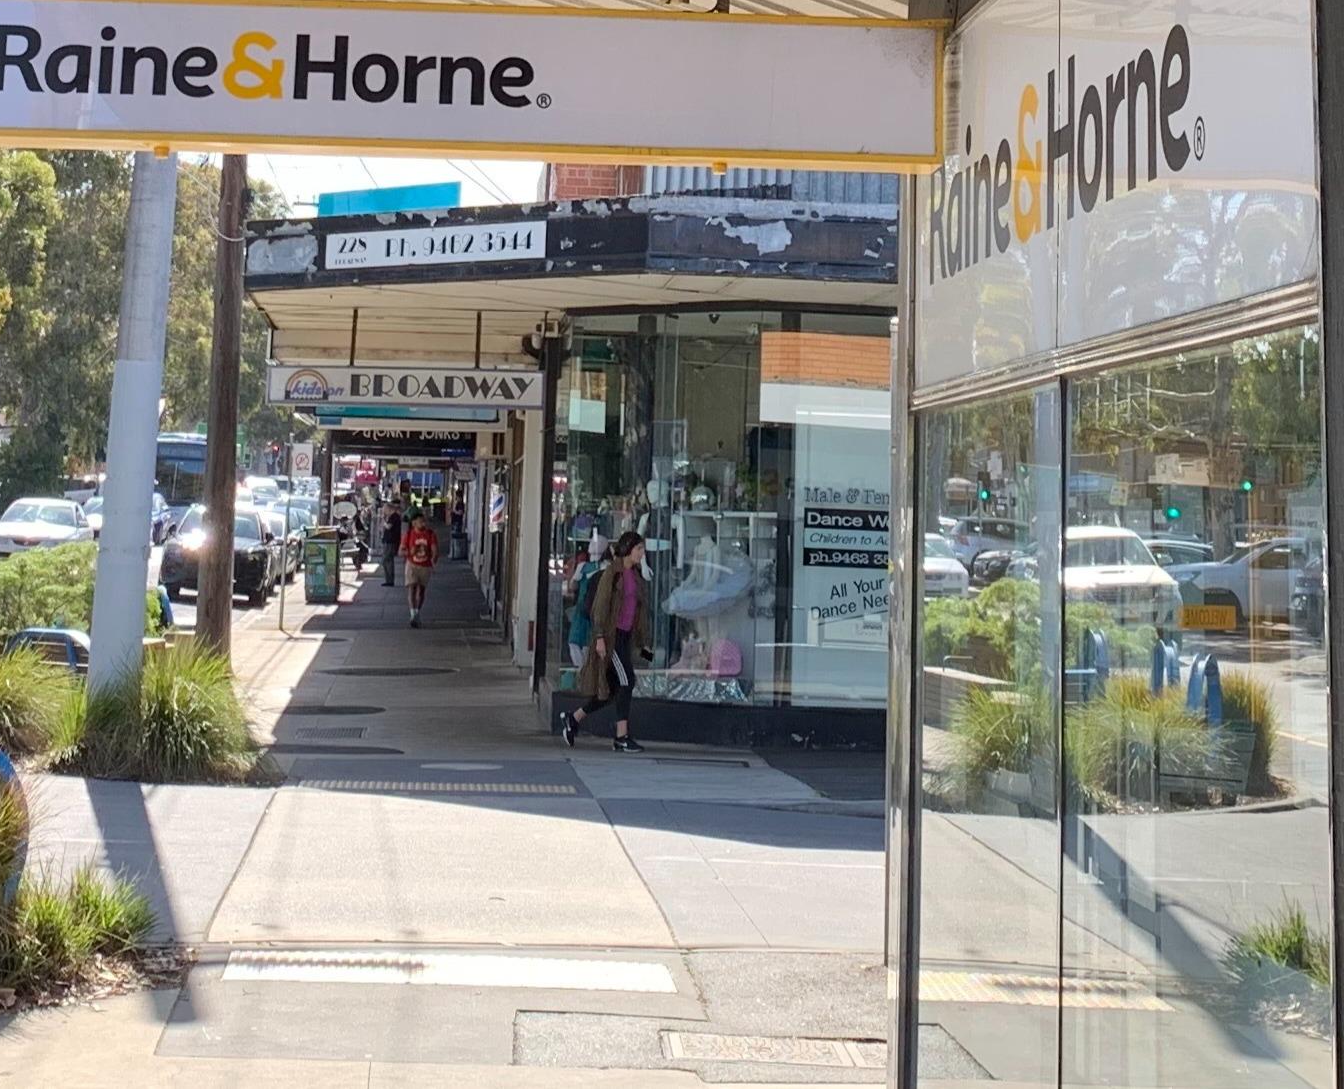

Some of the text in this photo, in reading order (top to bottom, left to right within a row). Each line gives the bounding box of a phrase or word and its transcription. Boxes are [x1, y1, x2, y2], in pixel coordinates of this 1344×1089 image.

[338, 228, 534, 258] 228 Ph. 9462 3544
[293, 373, 535, 400] kids on BROADWAY
[805, 486, 842, 504] Male
[846, 488, 860, 504] &
[807, 512, 864, 527] Dance
[809, 532, 857, 546] Children
[860, 535, 872, 546] to
[809, 551, 870, 566] ph.9462
[830, 578, 885, 600] All Your
[810, 602, 857, 621] Dance
